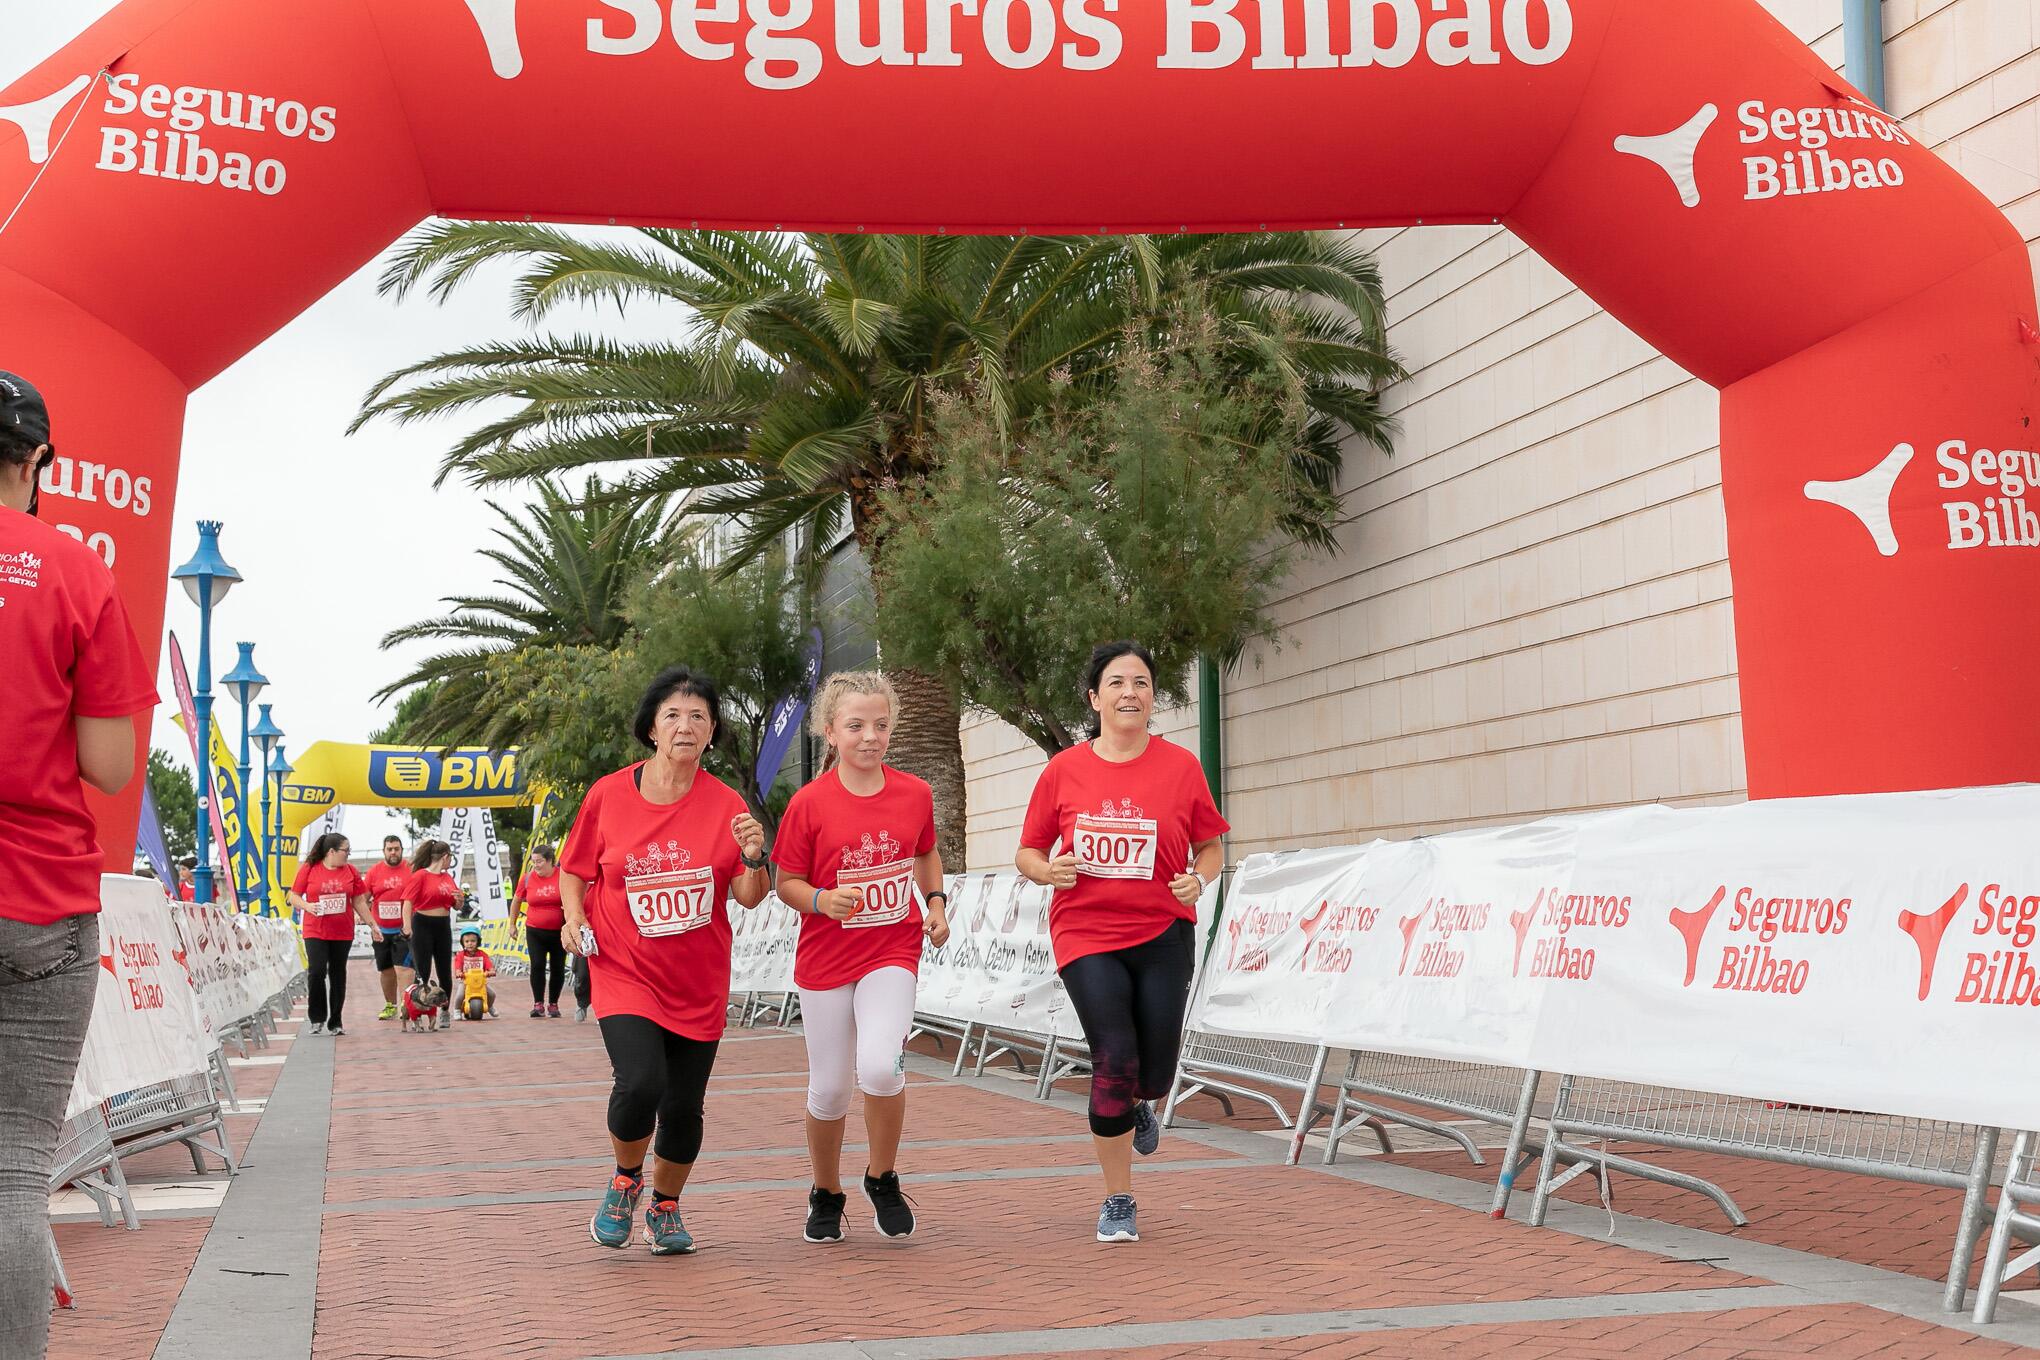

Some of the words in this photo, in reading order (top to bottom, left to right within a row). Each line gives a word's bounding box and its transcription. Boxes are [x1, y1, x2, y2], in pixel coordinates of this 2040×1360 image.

[586, 0, 1123, 91] Seguros
[1156, 0, 1574, 69] Bilbao
[103, 73, 337, 143] Seguros
[1737, 100, 1911, 149] Seguros
[95, 126, 287, 196] Bilbao
[1742, 149, 1904, 200] Bilbao
[39, 456, 152, 517] uros
[1936, 439, 2040, 498] Segu
[1942, 496, 2040, 550] Bilb
[8, 576, 37, 588] GETXO
[302, 787, 331, 803] BM
[439, 754, 516, 791] BM
[481, 807, 498, 871] CORR
[1081, 834, 1148, 865] 3007
[323, 898, 345, 910] 3009
[489, 878, 502, 900] EL
[637, 886, 707, 924] 3007
[1543, 886, 1632, 935] Seguros
[1428, 897, 1491, 940] Seguros
[1729, 886, 1852, 943] Seguros
[1413, 942, 1464, 978] Bilbao
[1529, 937, 1596, 981] Bilbao
[1712, 944, 1810, 995] Bilbao
[1955, 950, 2040, 1006] Bilb
